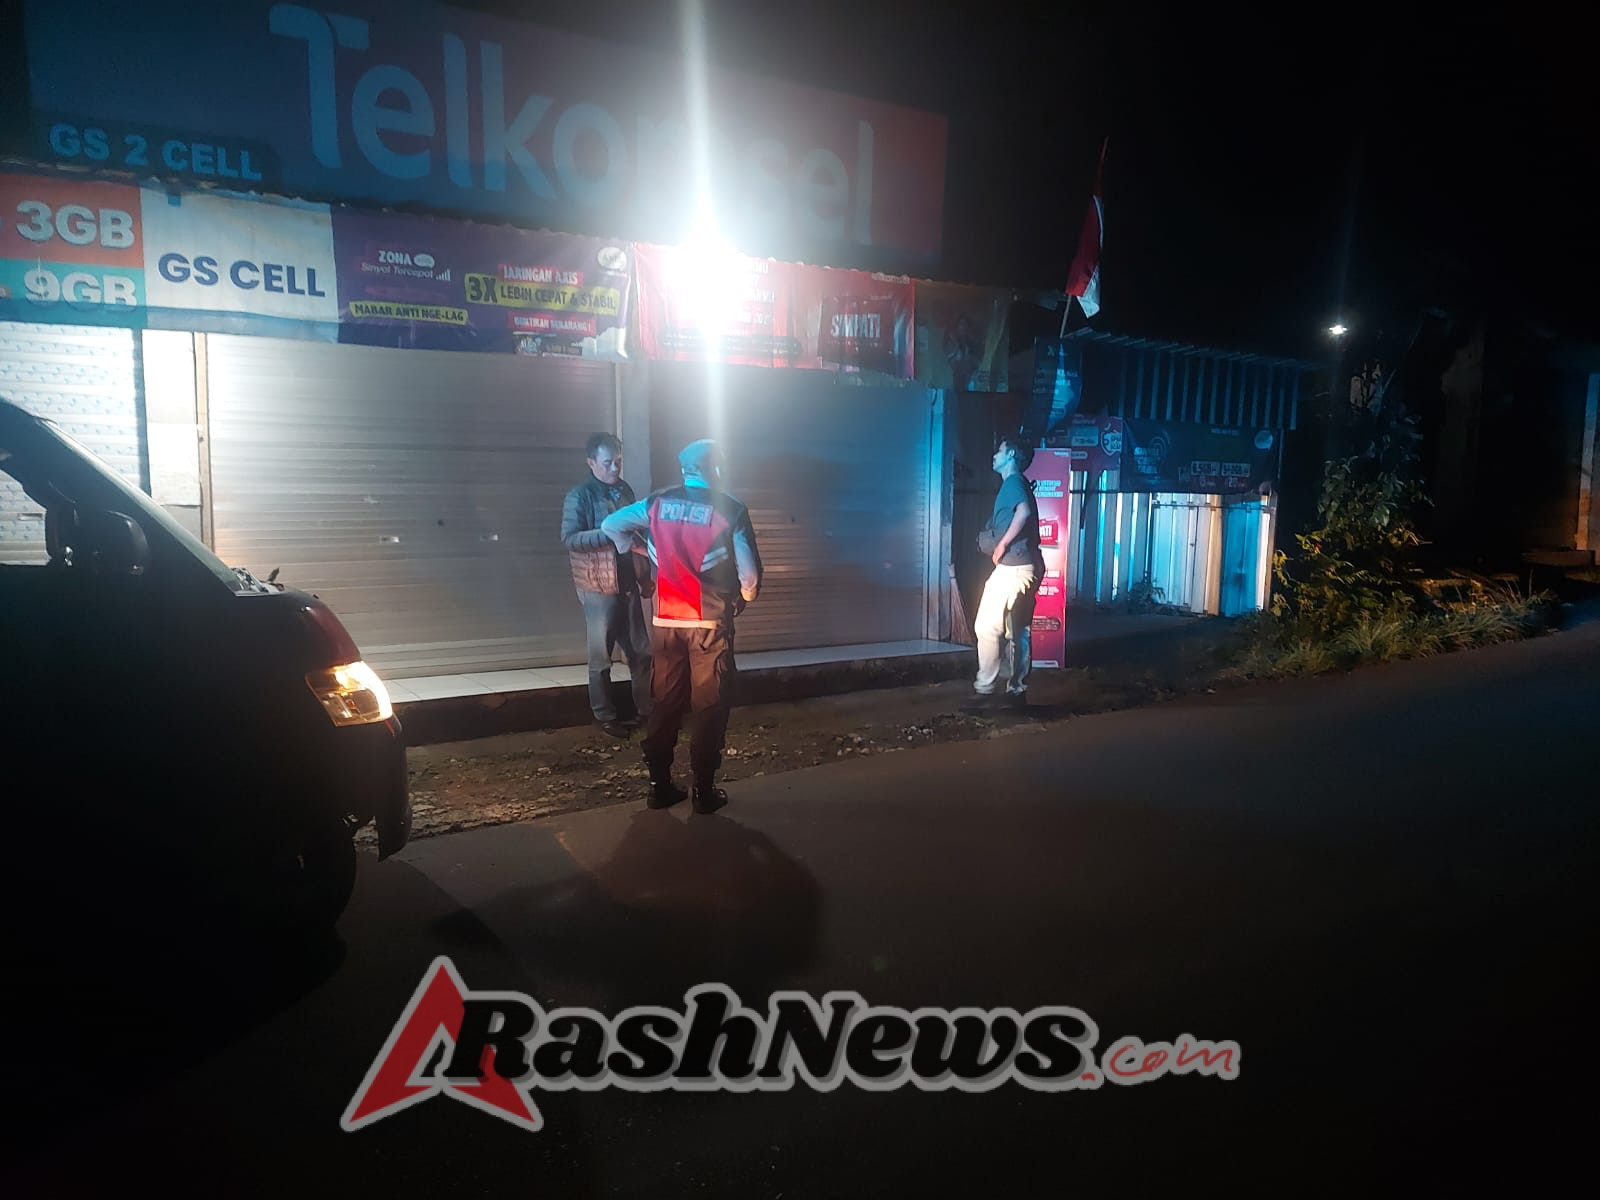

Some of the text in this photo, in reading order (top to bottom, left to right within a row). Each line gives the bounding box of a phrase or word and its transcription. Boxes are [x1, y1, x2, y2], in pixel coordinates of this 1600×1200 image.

[49, 123, 263, 182] GS 2 CELL
[16, 199, 135, 249] 3GB
[378, 250, 412, 266] ZONA
[158, 252, 326, 298] GS CELL
[24, 268, 138, 310] 9GB
[468, 276, 497, 303] 3X
[500, 285, 532, 302] LEBIH
[355, 303, 464, 322] MABAR ANTI NGE-LAG
[660, 502, 713, 526] POLISI
